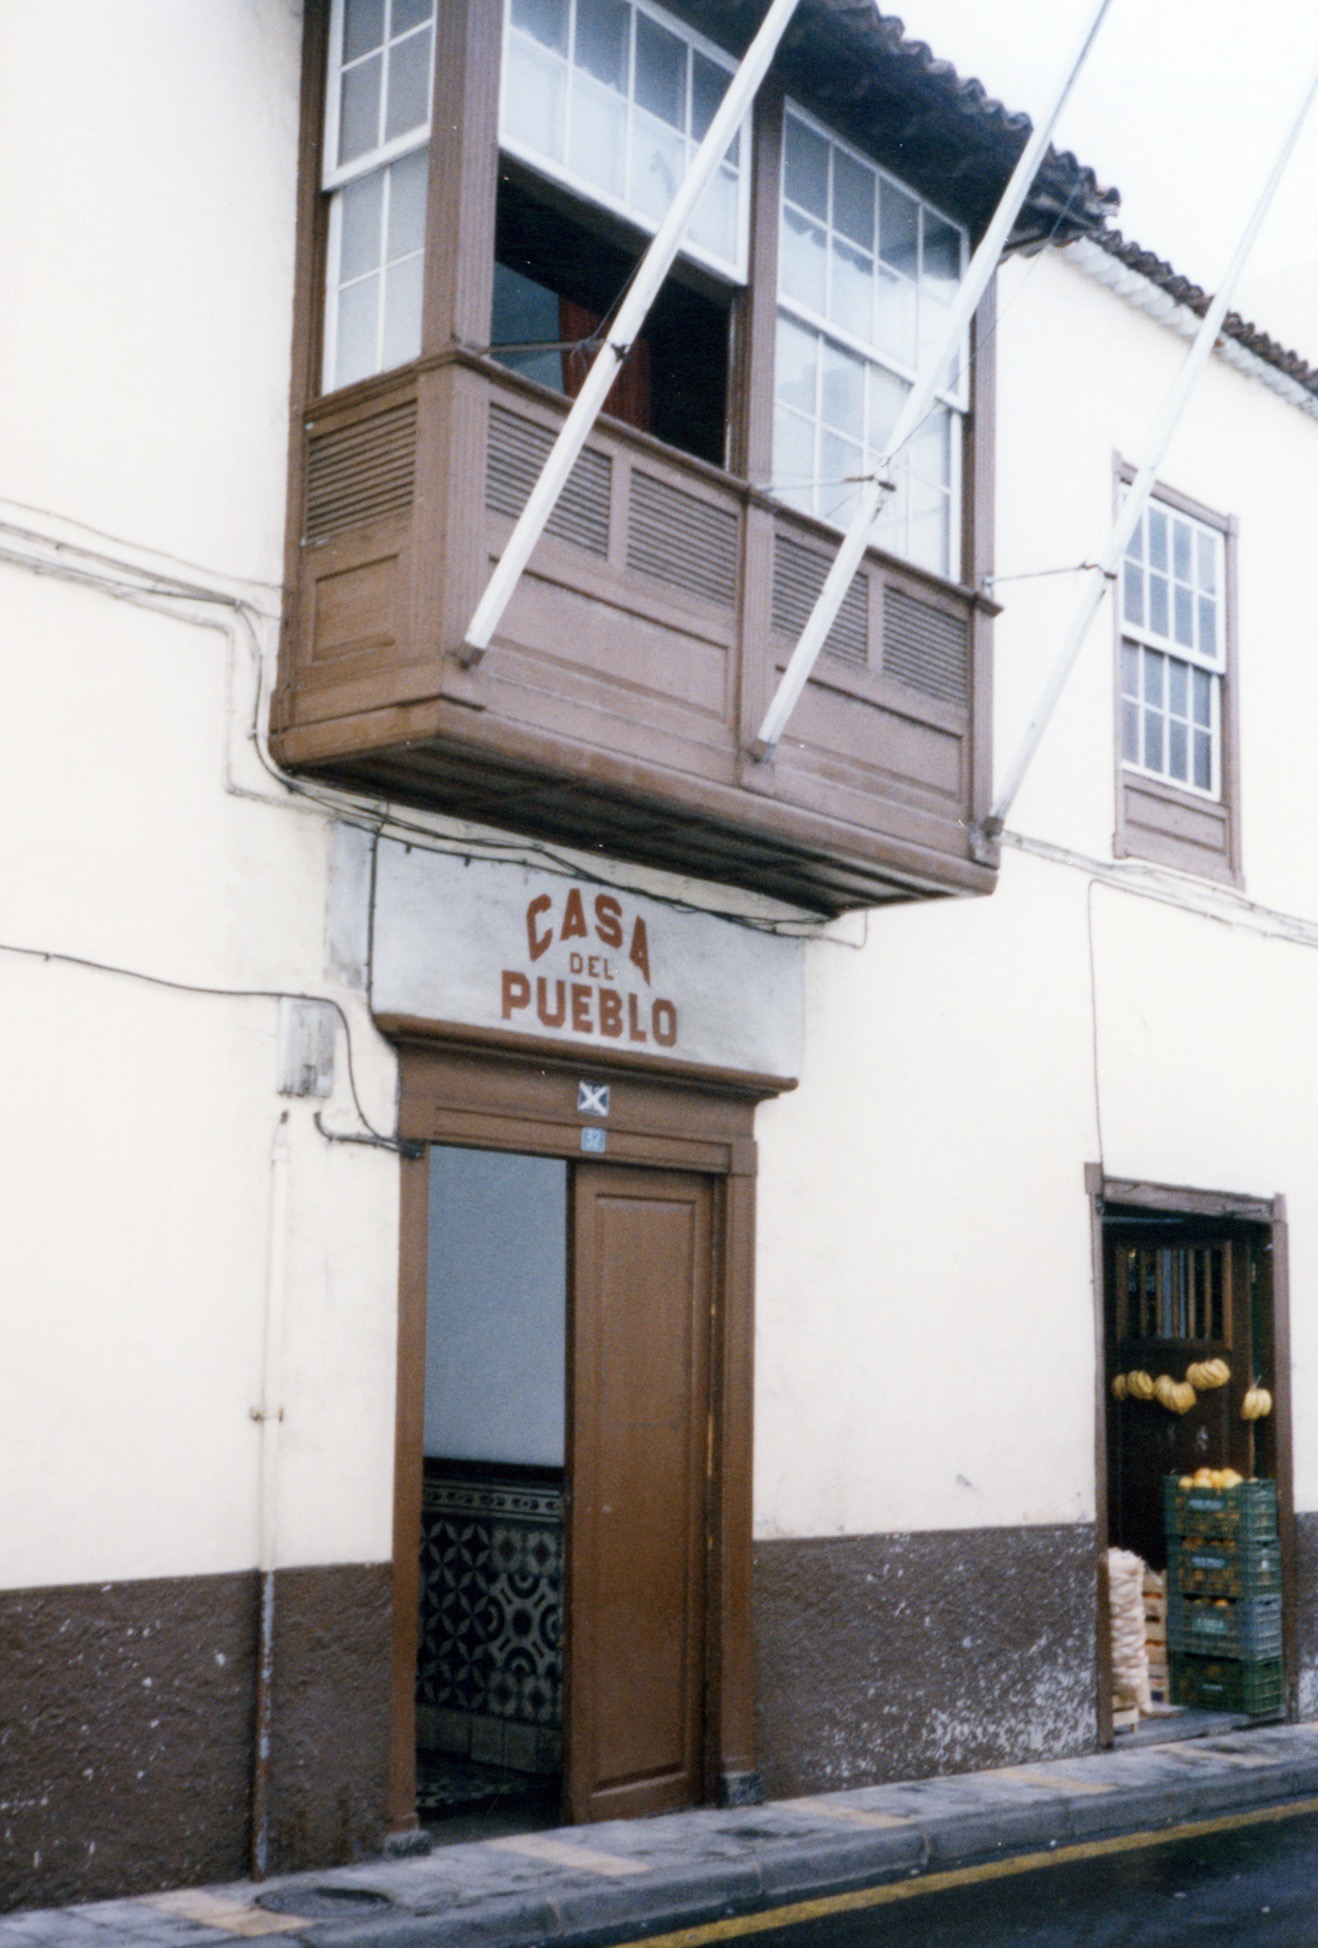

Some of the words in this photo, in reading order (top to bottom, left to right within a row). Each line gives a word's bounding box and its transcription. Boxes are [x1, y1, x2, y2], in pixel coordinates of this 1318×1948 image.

[526, 888, 651, 988] CASA
[570, 952, 614, 980] DEL
[501, 970, 678, 1048] PUEBLO
